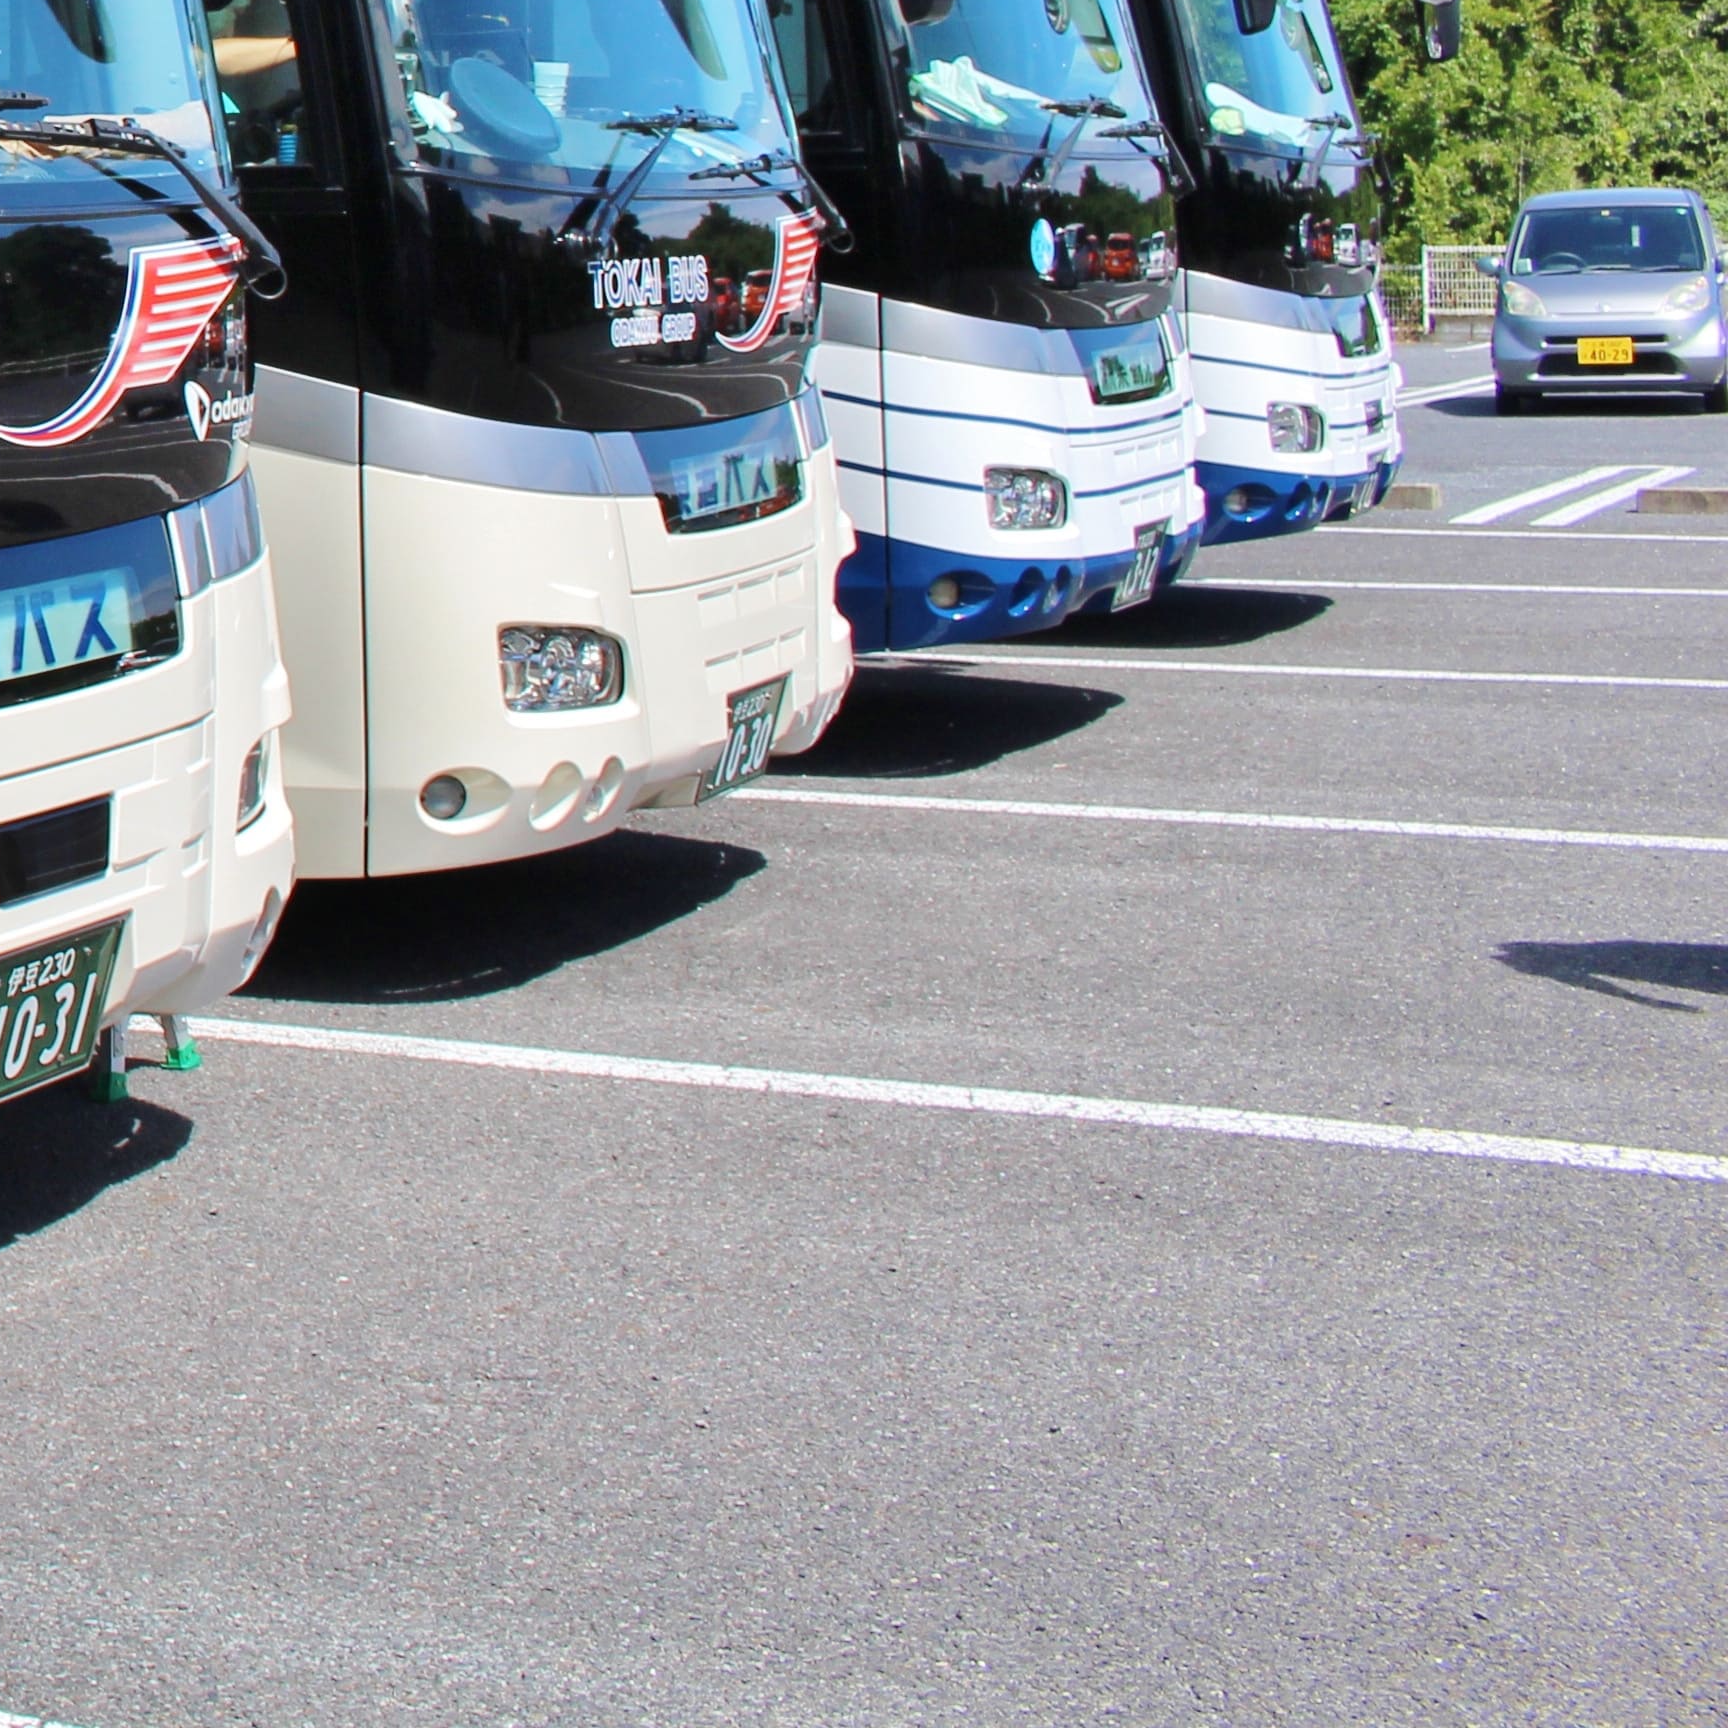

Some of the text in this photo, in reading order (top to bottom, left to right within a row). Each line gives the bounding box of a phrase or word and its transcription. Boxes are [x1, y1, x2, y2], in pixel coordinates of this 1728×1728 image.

[588, 255, 709, 309] TOKAI BUS
[661, 312, 697, 343] GROUP
[715, 713, 773, 787] 10-30
